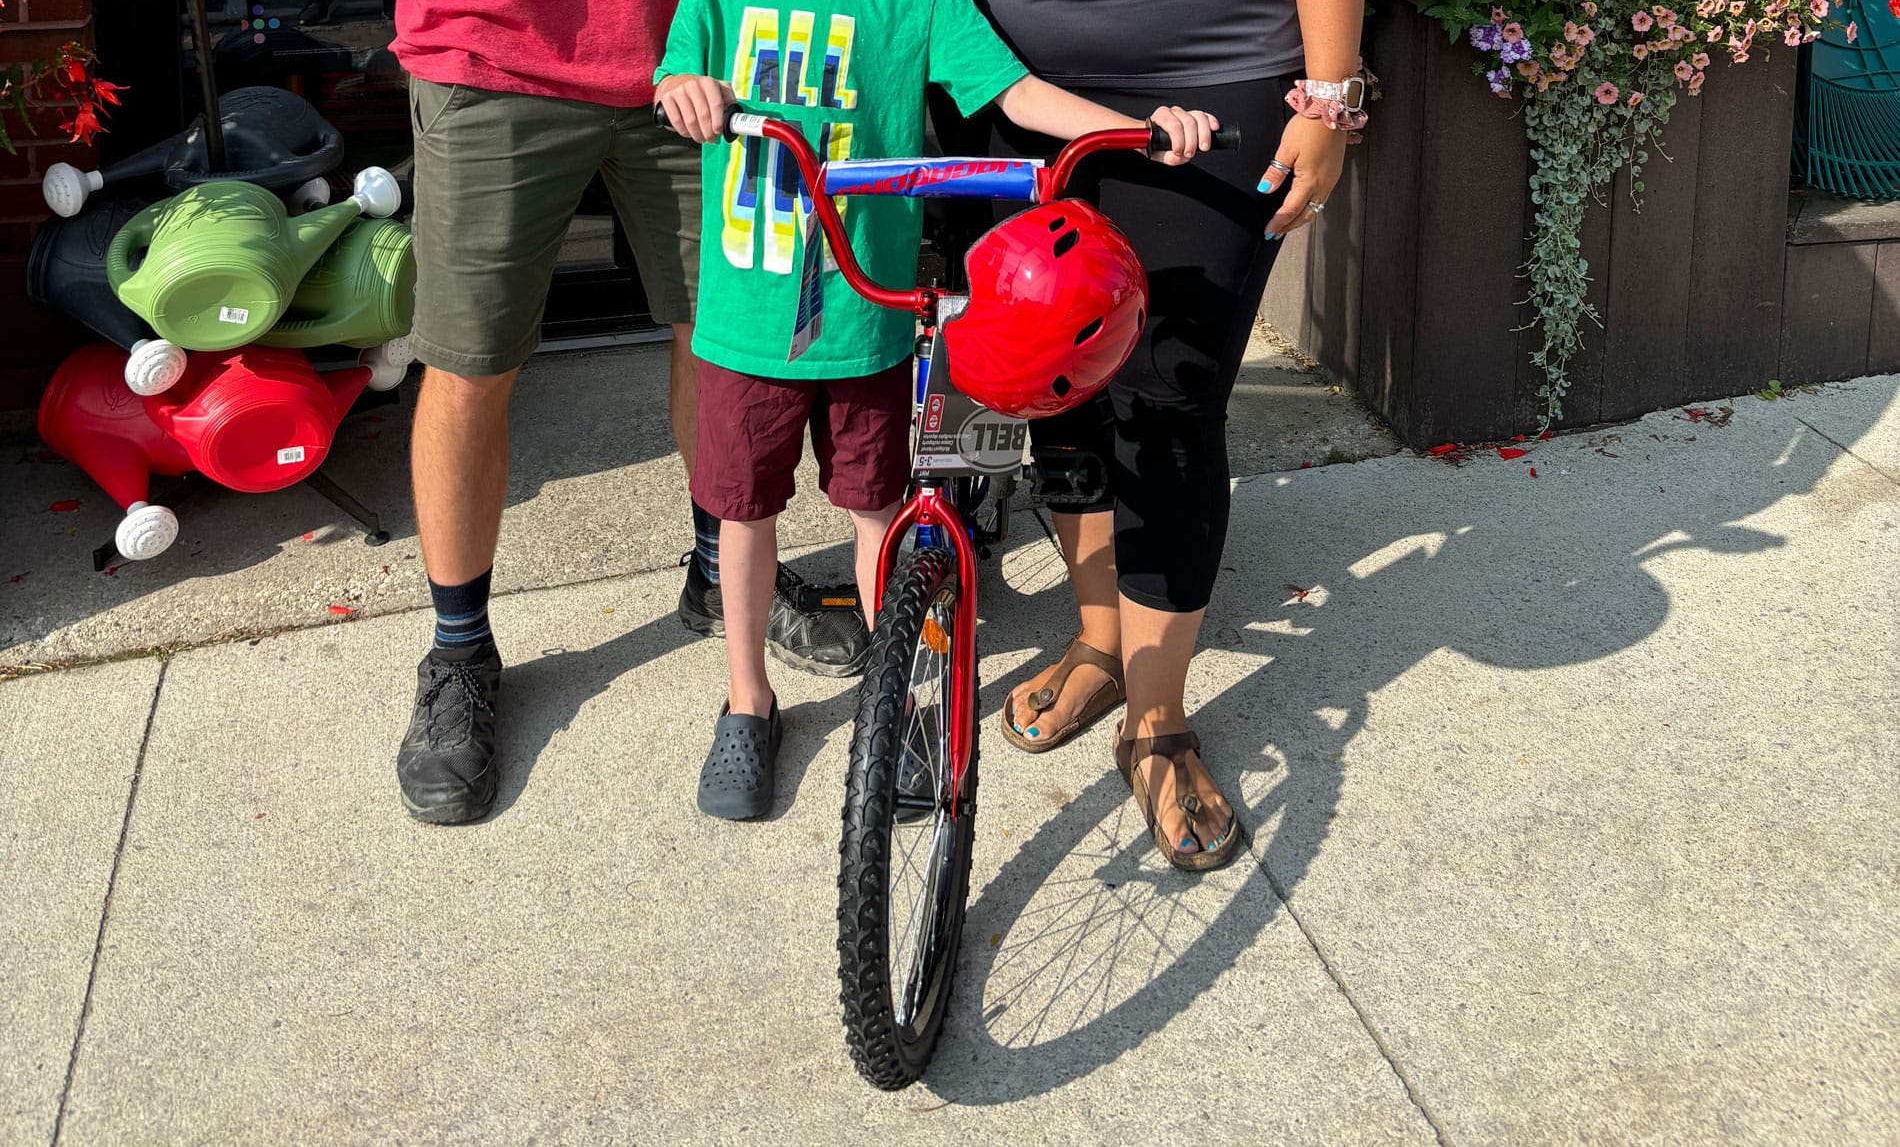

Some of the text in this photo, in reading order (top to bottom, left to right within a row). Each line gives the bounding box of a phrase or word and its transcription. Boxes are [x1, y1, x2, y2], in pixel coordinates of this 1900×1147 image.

[731, 5, 857, 110] ALL
[972, 423, 1028, 452] BELL
[919, 456, 933, 467] 3-5
